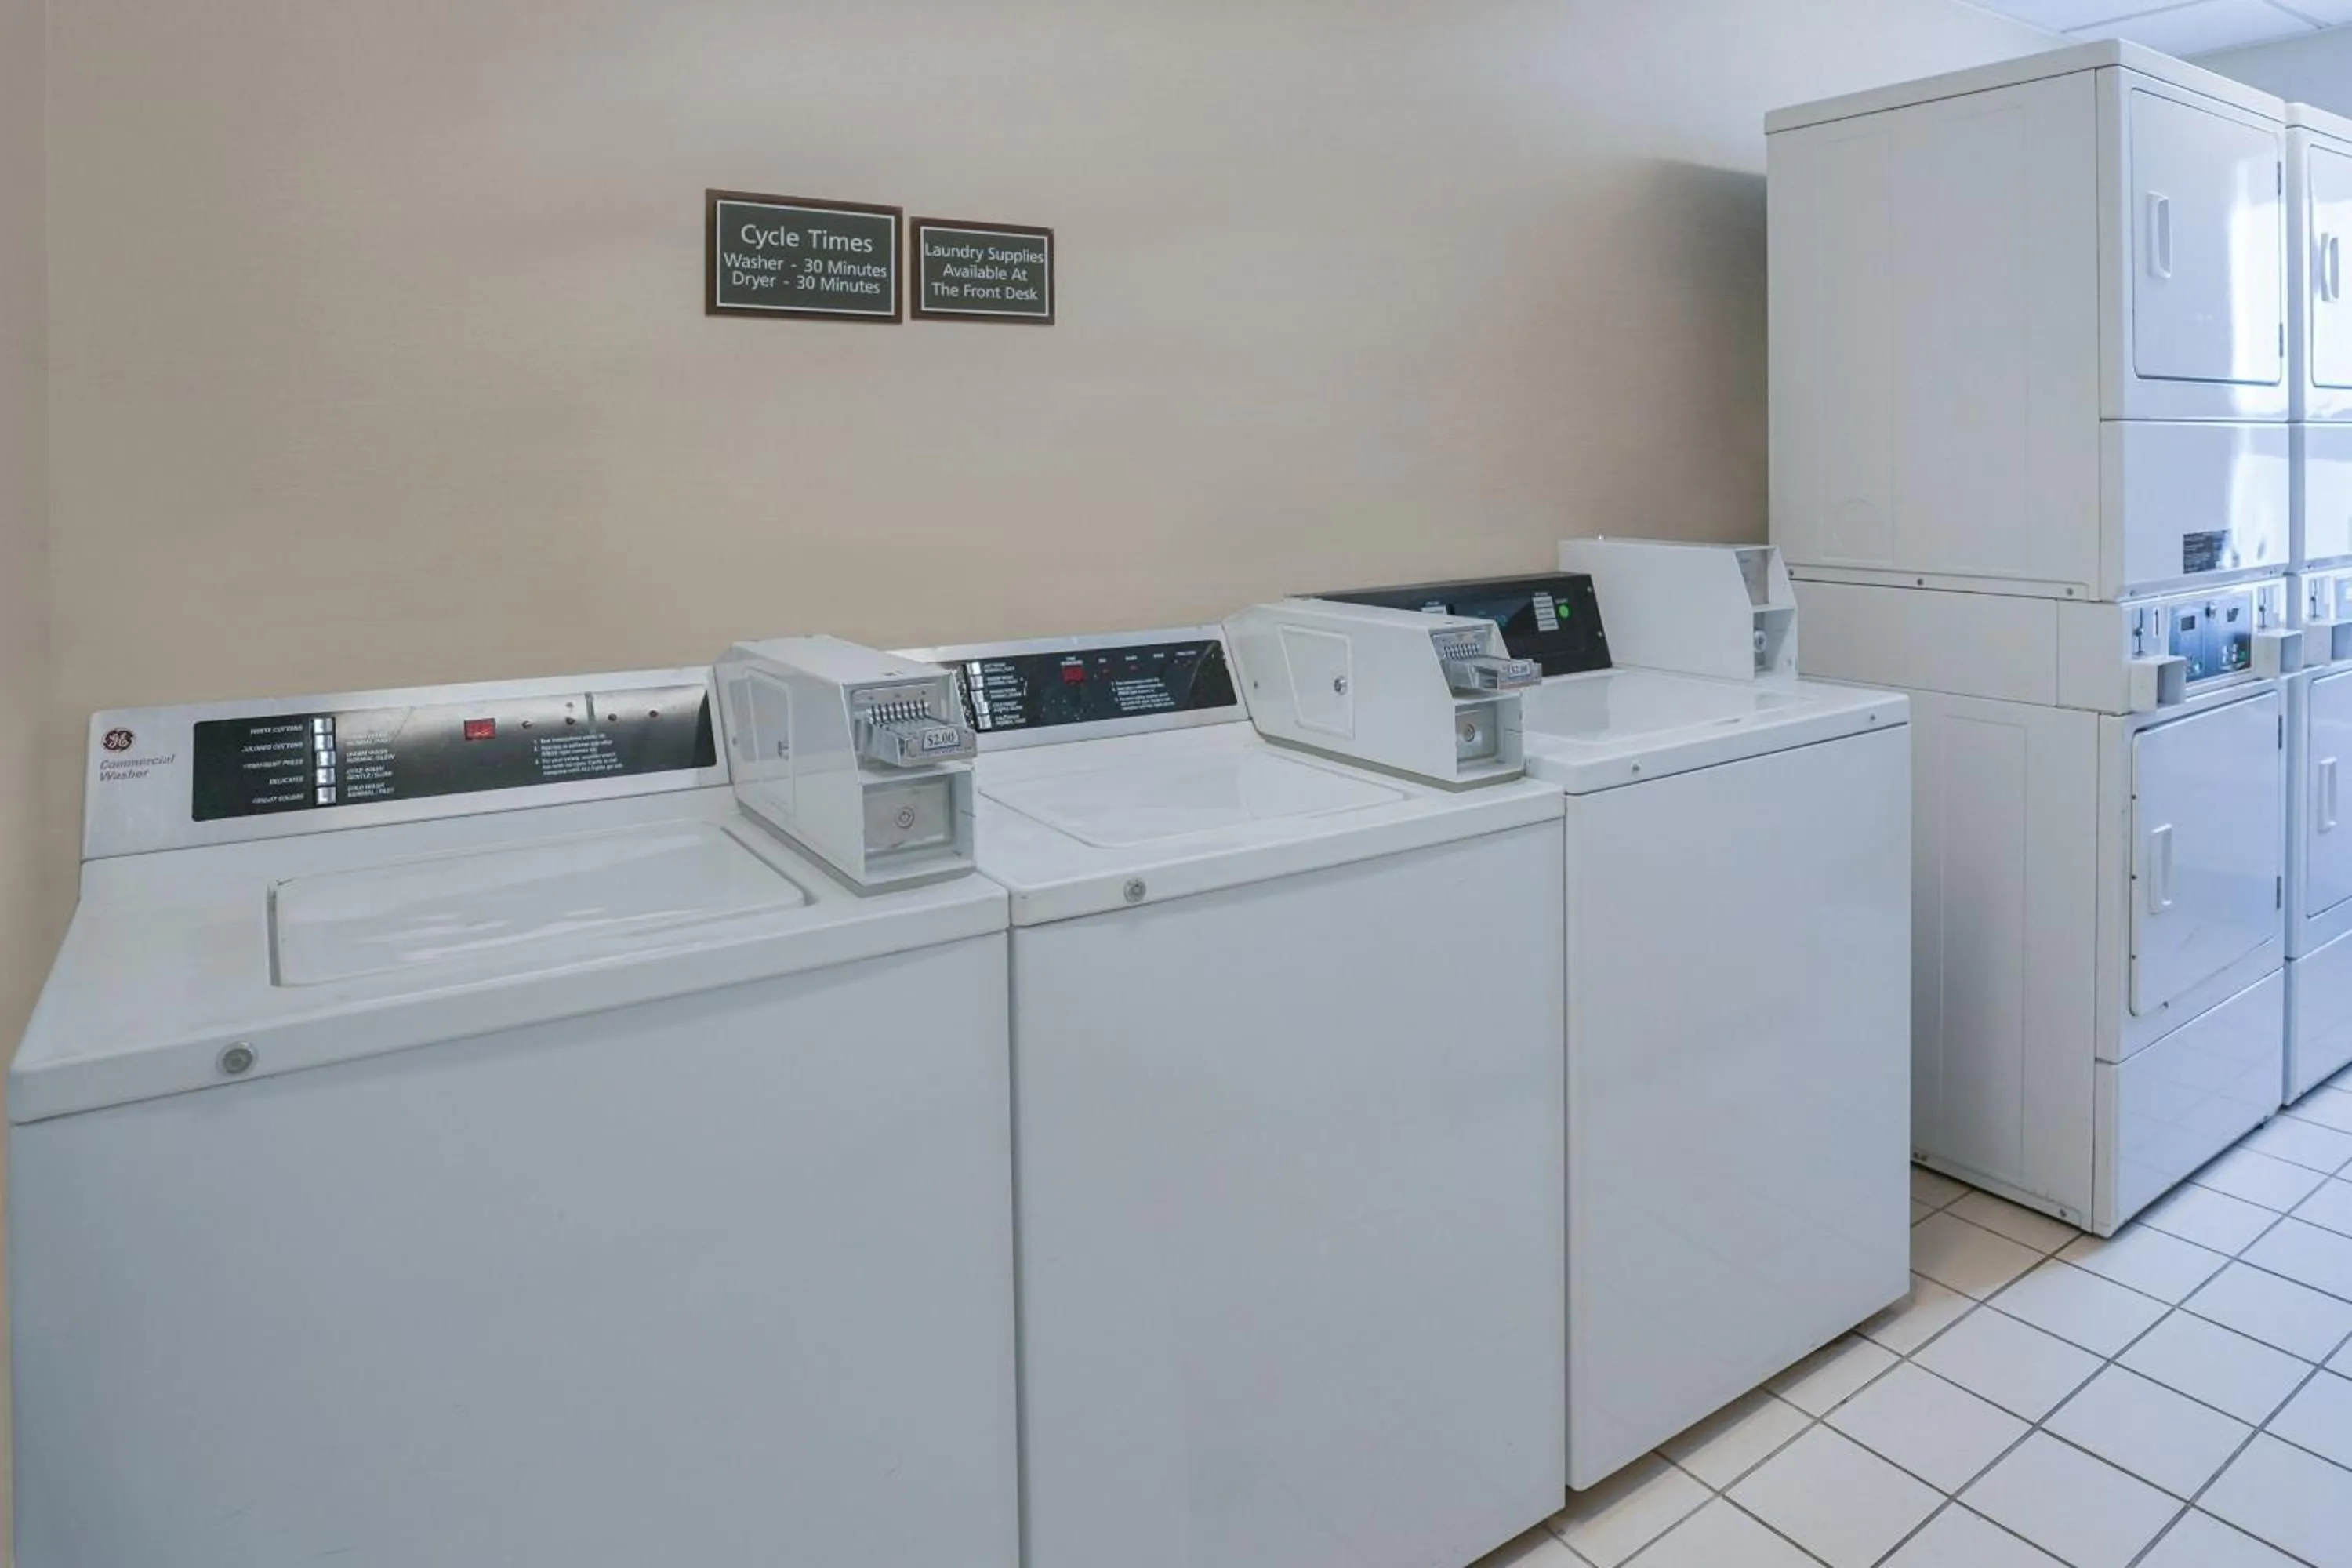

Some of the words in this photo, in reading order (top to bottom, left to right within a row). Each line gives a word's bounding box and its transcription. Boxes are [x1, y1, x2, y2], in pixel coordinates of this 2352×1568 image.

[740, 223, 800, 249] Cycle
[808, 229, 873, 252] Times
[924, 242, 984, 263] Laundry
[988, 247, 1044, 265] Supplies
[724, 252, 784, 270] Washer
[804, 258, 823, 274] 30
[827, 260, 887, 278] Minutes
[942, 263, 1007, 281] Available
[1011, 268, 1029, 281] At
[731, 270, 776, 290] Dryer
[796, 275, 815, 290] 30
[820, 278, 881, 294] Minutes
[931, 281, 960, 297] The
[964, 284, 1001, 299] Front
[1005, 286, 1039, 301] Desk
[927, 731, 955, 747] $2.00
[100, 753, 176, 771] Commercial
[100, 769, 151, 782] Washer
